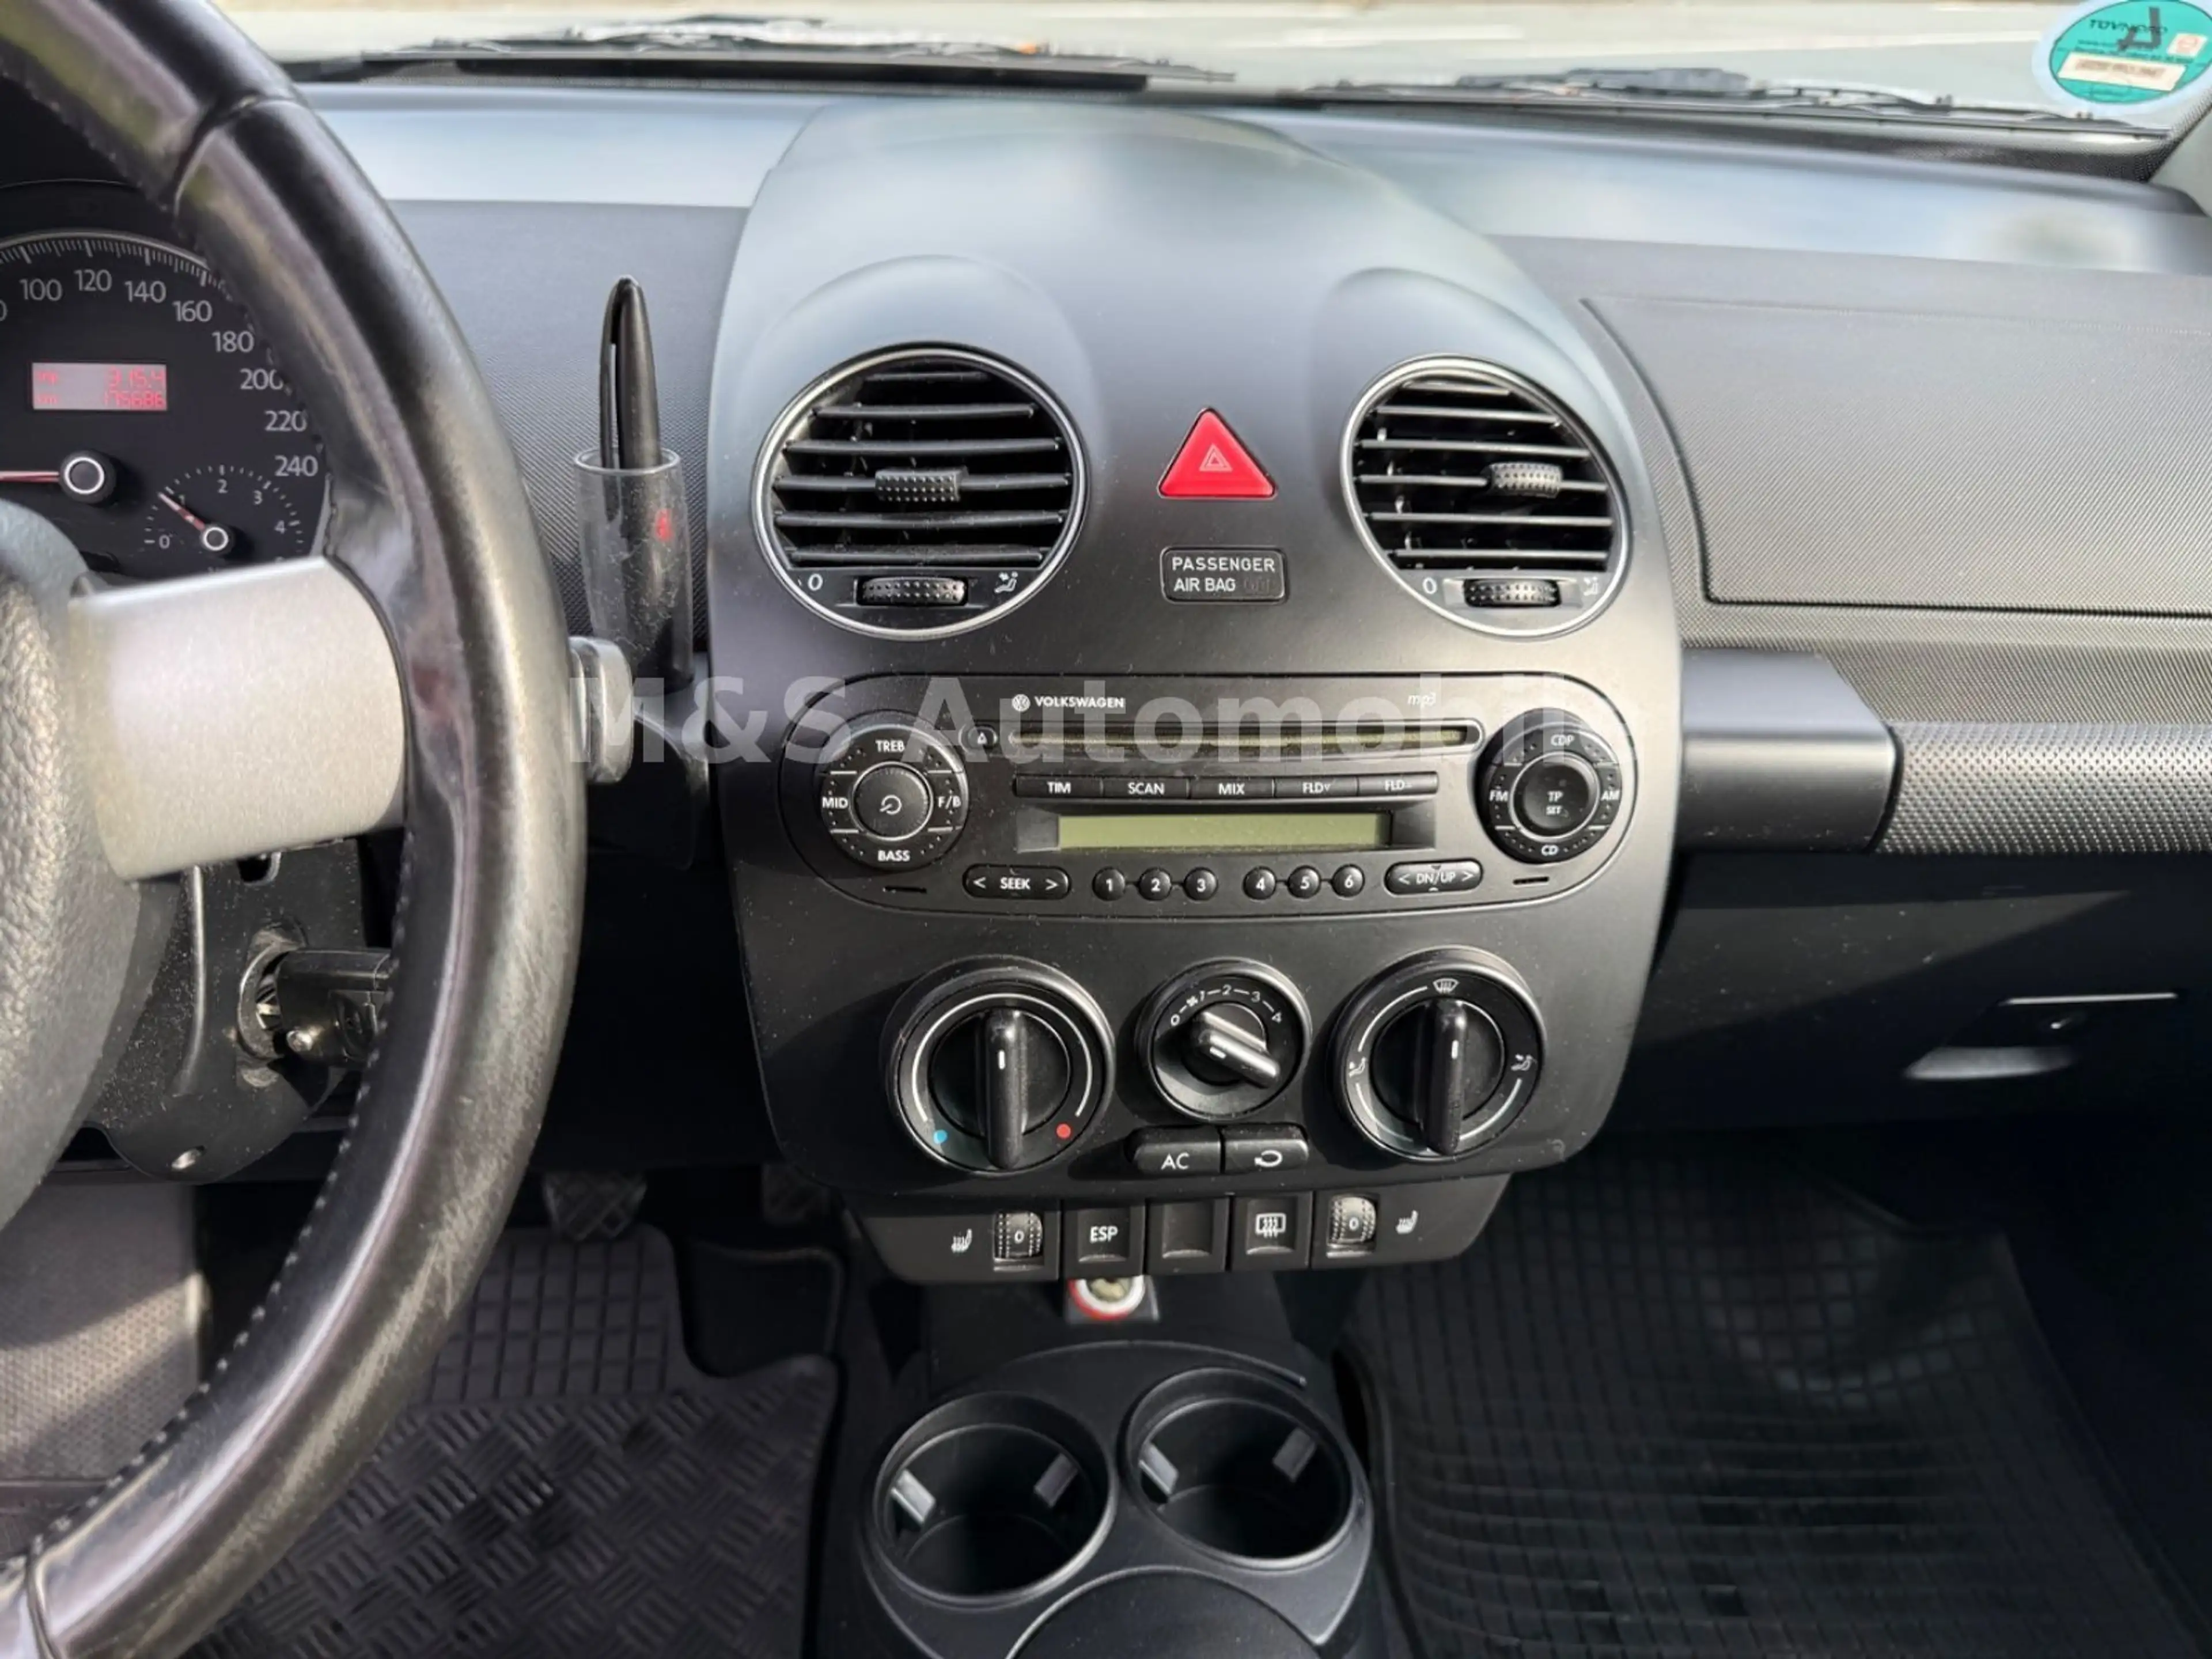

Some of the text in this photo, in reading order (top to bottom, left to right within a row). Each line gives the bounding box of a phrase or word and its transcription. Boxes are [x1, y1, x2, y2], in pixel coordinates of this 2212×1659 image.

[74, 268, 112, 291] 120
[19, 278, 62, 301] 100
[124, 280, 166, 303] 140
[172, 300, 213, 322] 160
[211, 330, 254, 353] 180
[264, 410, 307, 432] 220
[274, 454, 319, 477] 240
[217, 478, 228, 494] 2
[253, 490, 263, 505] 3
[274, 520, 286, 534] 4
[158, 533, 171, 549] 0
[1172, 556, 1275, 572] PASSENGER
[1173, 577, 1200, 592] AIR
[1205, 577, 1236, 592] BAG
[1034, 696, 1126, 709] VOLKSWAGEN
[1407, 691, 1437, 707] mp3
[876, 739, 906, 753] TREB
[1047, 781, 1071, 794] TIM
[1127, 782, 1165, 796] SCAN
[1218, 783, 1245, 796] MIX
[822, 797, 849, 808] MID
[938, 796, 961, 808] F/B
[1489, 790, 1509, 802] FM
[1547, 791, 1563, 802] TP
[1601, 790, 1620, 801] AM
[878, 850, 911, 862] BASS
[999, 877, 1031, 890] SEEK
[1105, 879, 1113, 891] 1
[1150, 878, 1161, 892] 2
[1196, 878, 1207, 892] 3
[1255, 877, 1266, 891] 4
[1300, 876, 1310, 890] 5
[1343, 874, 1354, 888] 6
[1416, 872, 1456, 885] DN/UP
[1221, 984, 1233, 997] 2
[1251, 991, 1261, 1003] 3
[1170, 1013, 1181, 1027] 0
[1271, 1012, 1282, 1024] 4
[1161, 1153, 1190, 1170] AC
[1089, 1225, 1119, 1243] ESP
